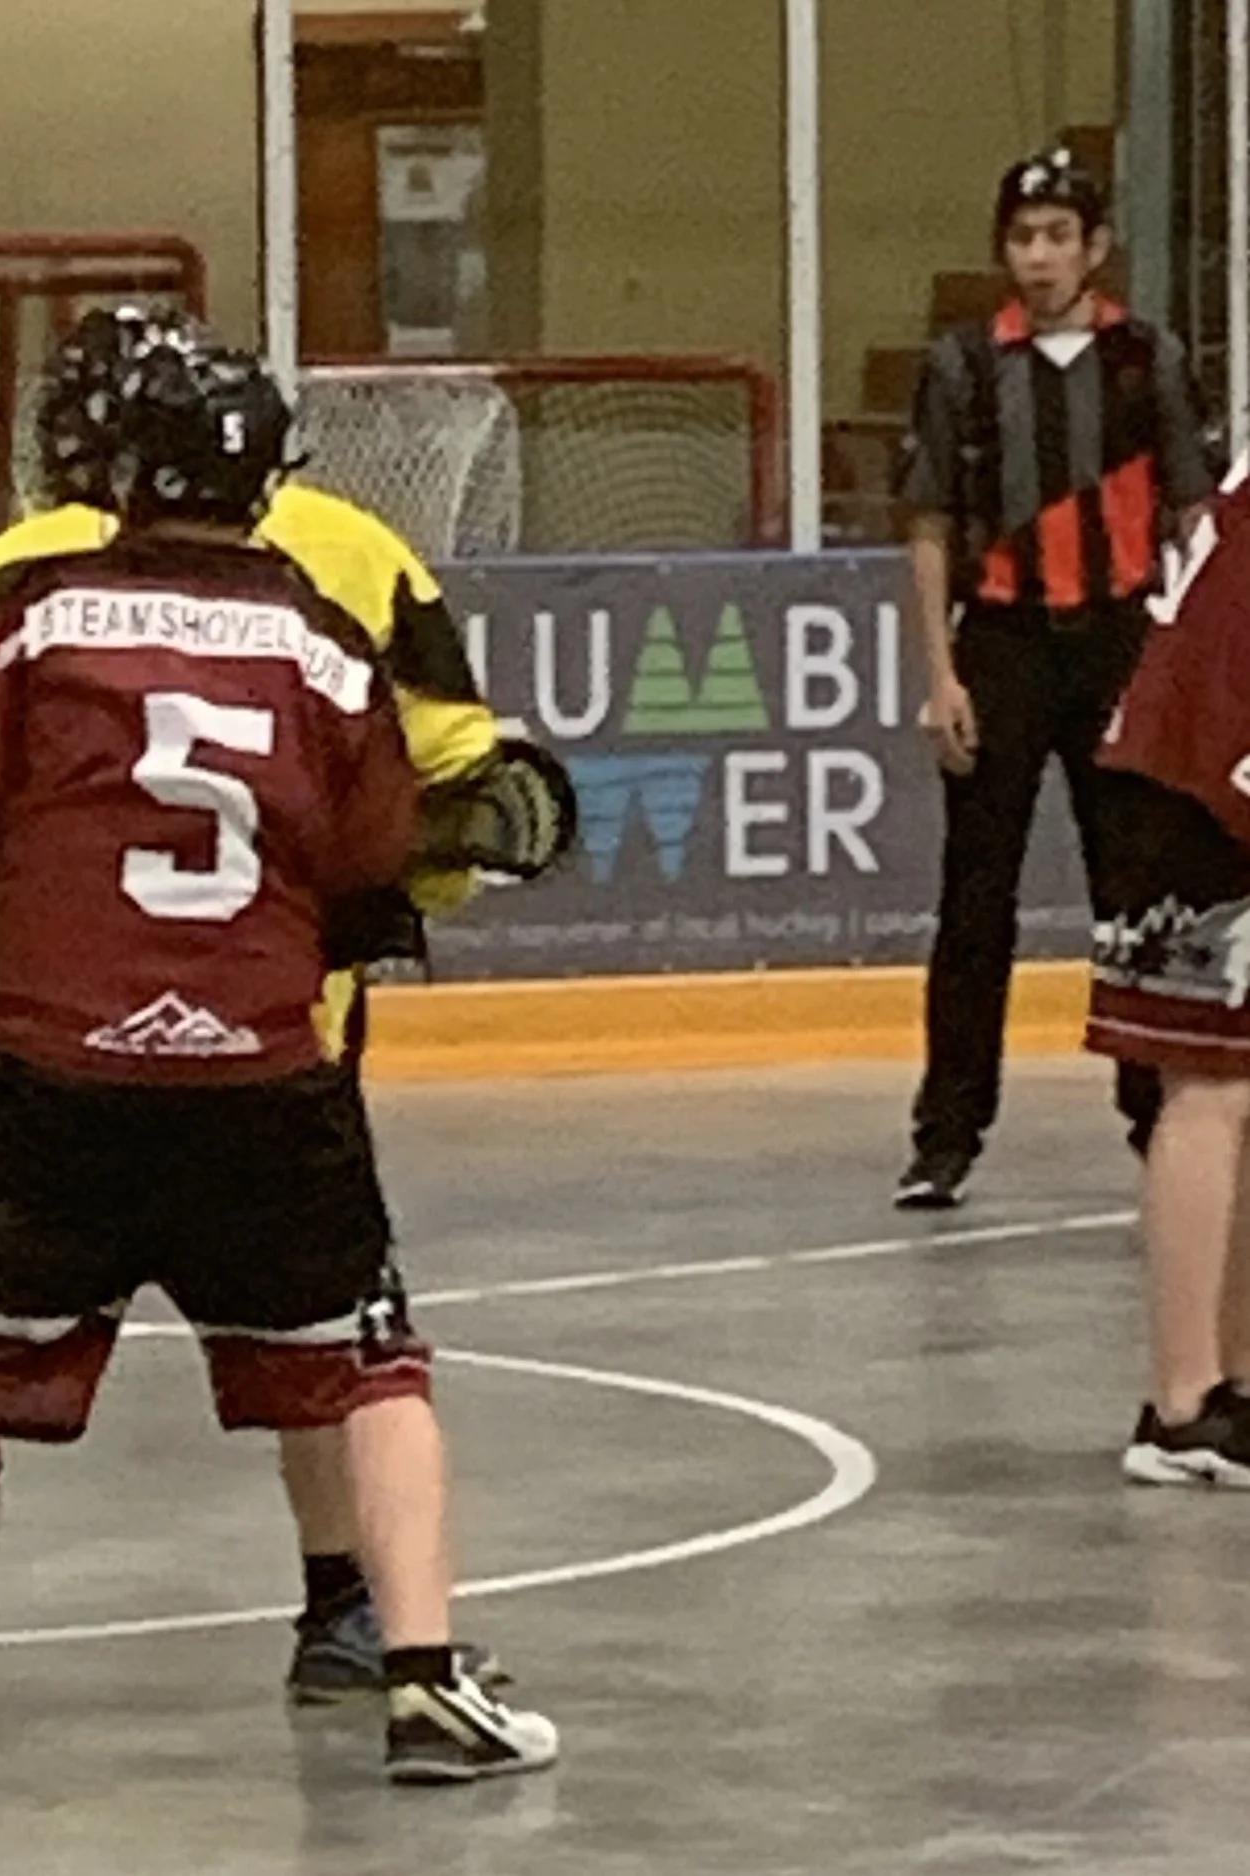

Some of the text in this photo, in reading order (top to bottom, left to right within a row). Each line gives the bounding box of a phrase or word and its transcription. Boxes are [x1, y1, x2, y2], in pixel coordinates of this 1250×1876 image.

[222, 410, 245, 454] 5
[39, 597, 293, 653] STEAMSHOVEL
[466, 602, 902, 740] LUMBI
[121, 691, 274, 922] 5
[566, 750, 885, 884] WER
